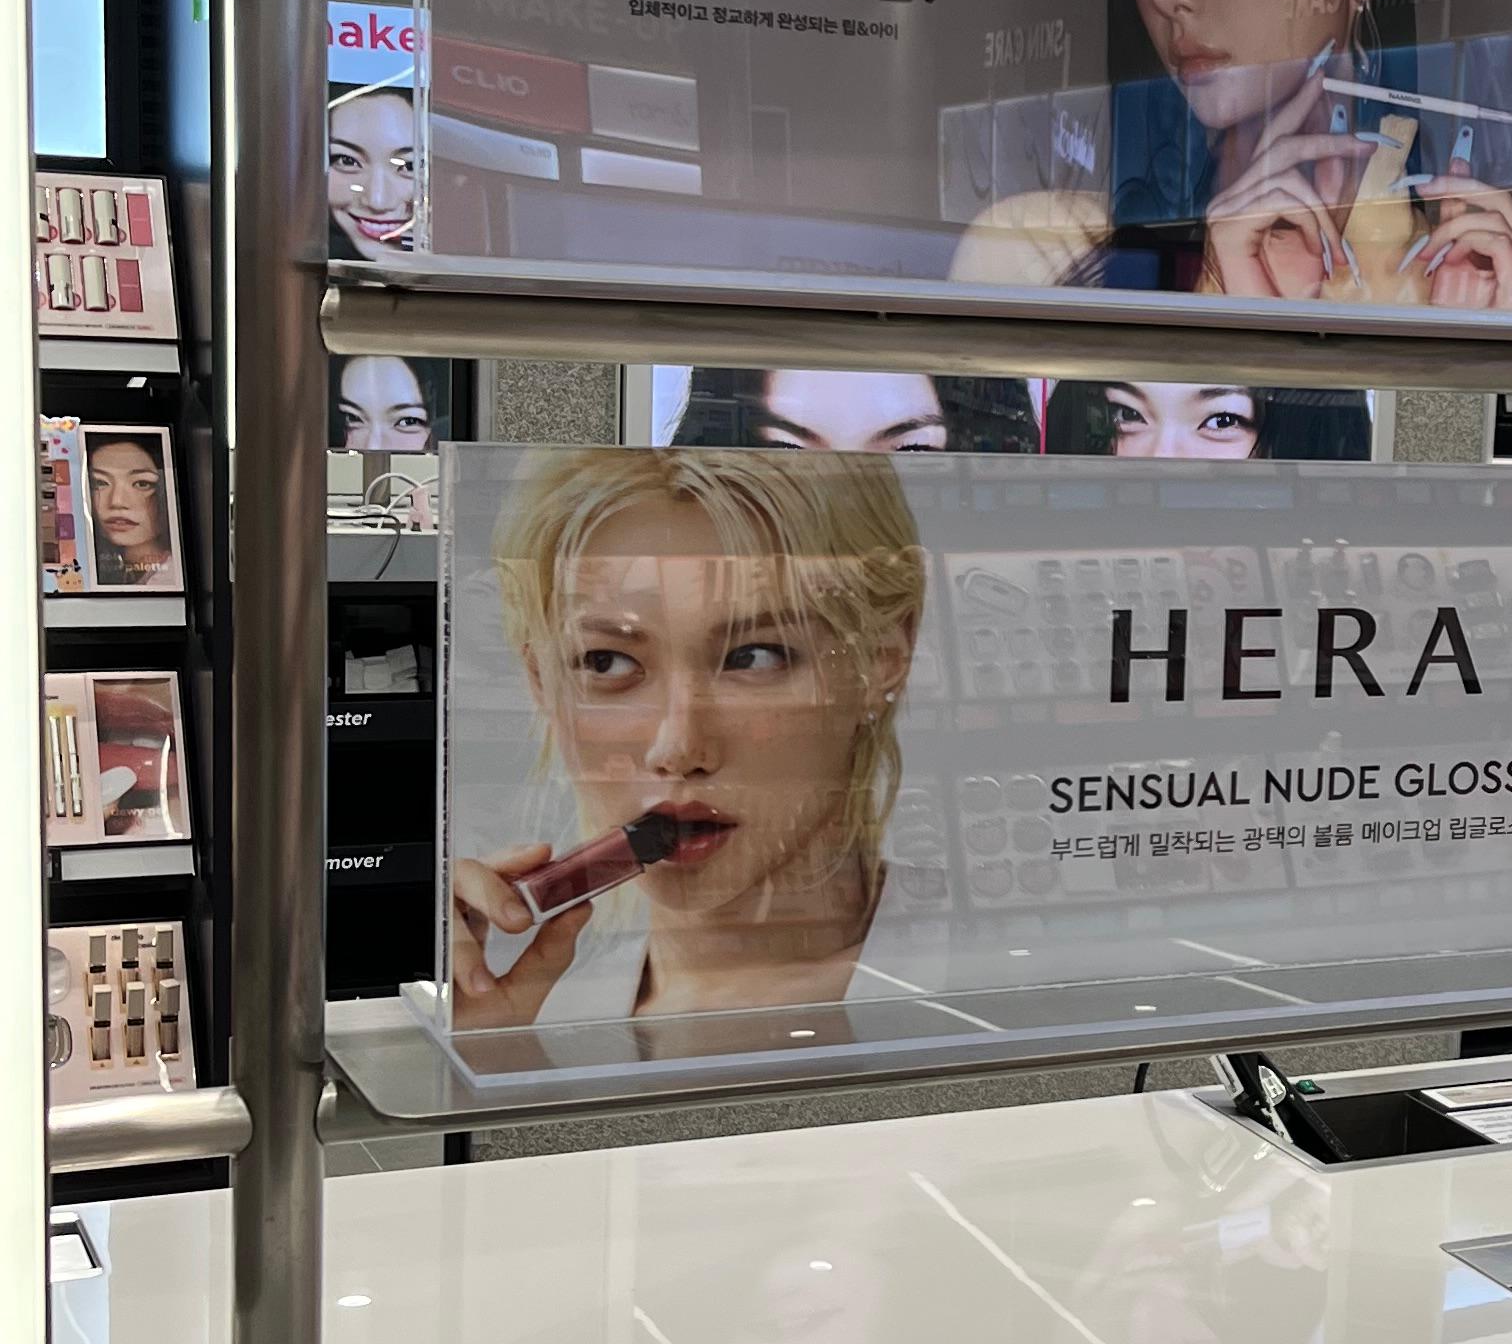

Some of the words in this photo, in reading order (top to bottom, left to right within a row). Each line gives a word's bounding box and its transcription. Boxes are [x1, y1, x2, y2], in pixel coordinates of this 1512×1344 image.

[628, 0, 709, 22] 입체적이고
[713, 8, 774, 27] 정교하게
[777, 15, 838, 34] 완성되는
[1109, 607, 1483, 703] HERA
[326, 712, 373, 727] ester
[1049, 768, 1251, 814] SENSUAL
[1264, 765, 1381, 803] NUDE
[1050, 833, 1140, 860] 부드럽게
[1149, 829, 1236, 856] 밀착되는
[1243, 825, 1306, 851] 광택의
[1313, 822, 1355, 848] 볼륨
[1362, 818, 1442, 844] 메이크업
[325, 855, 384, 870] mover
